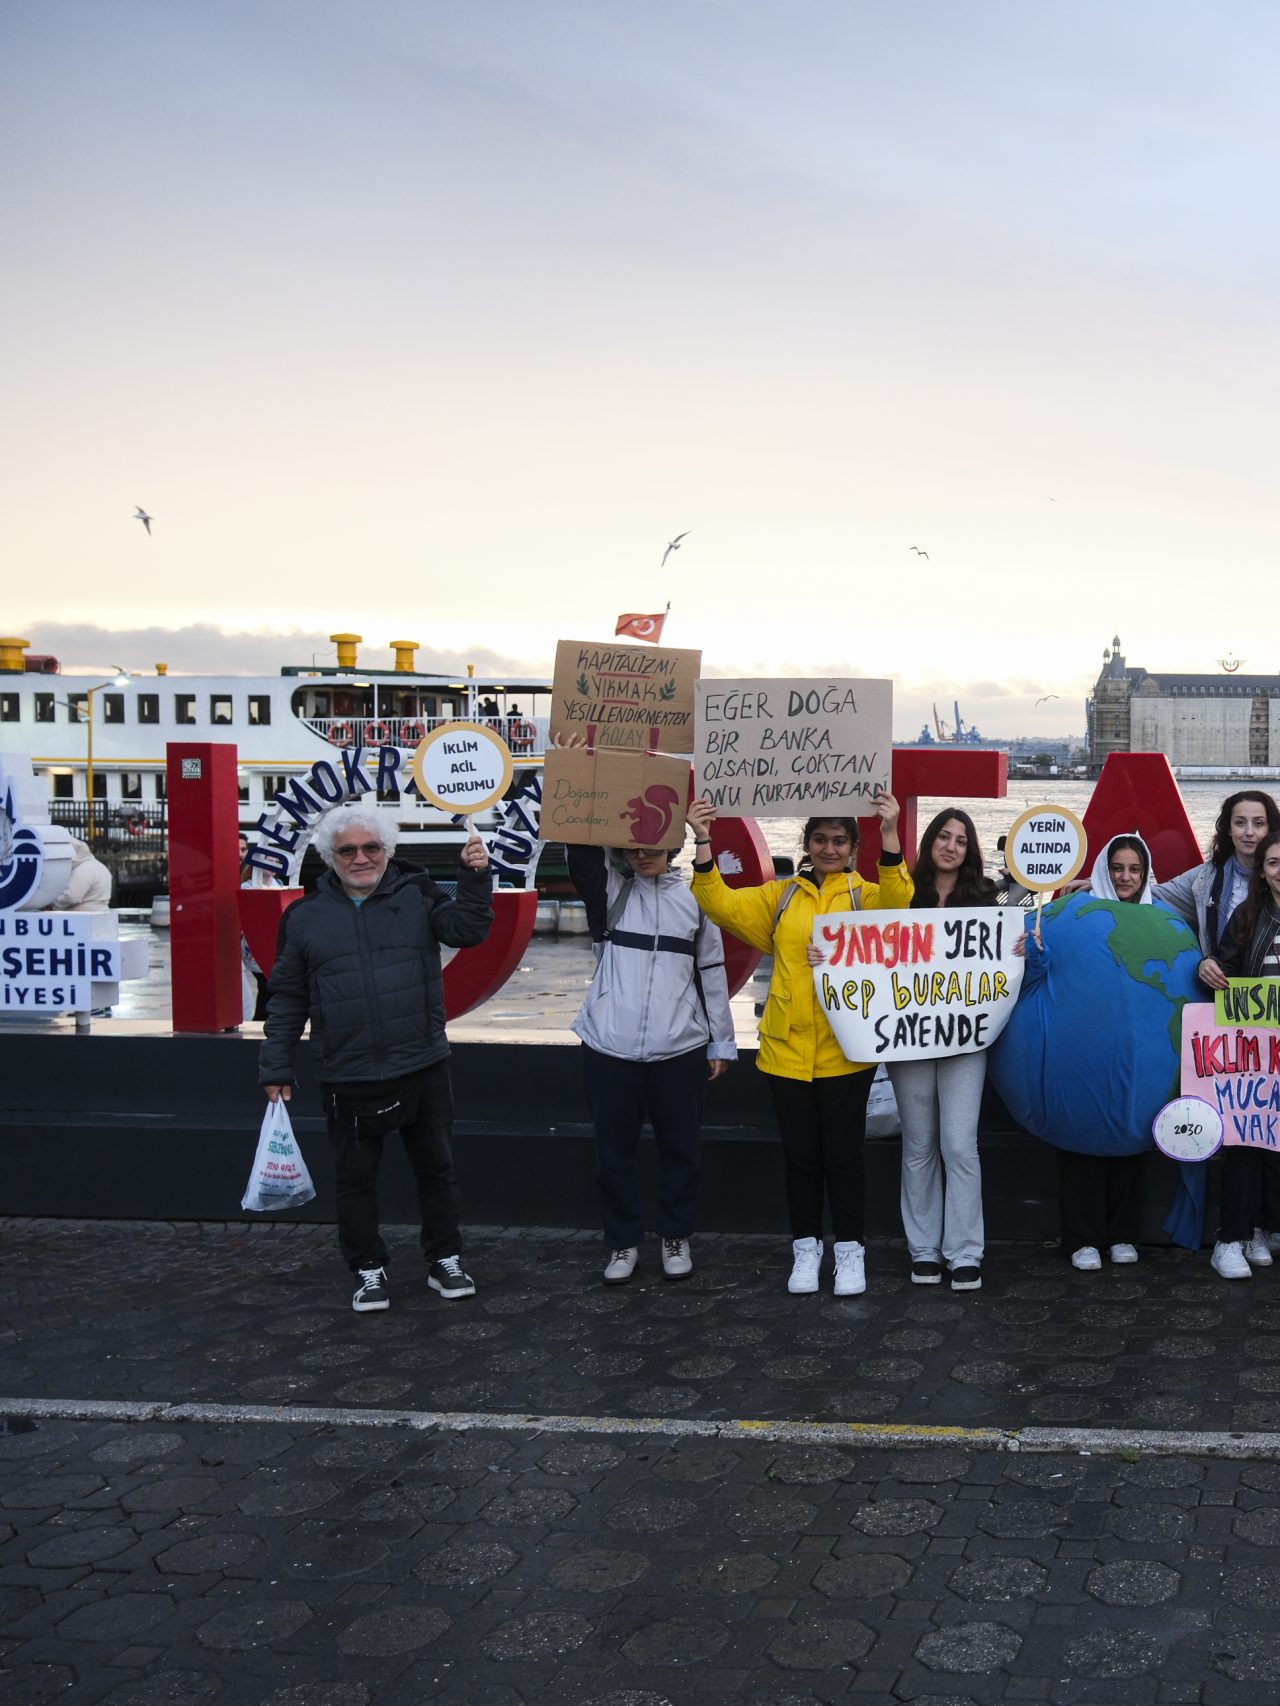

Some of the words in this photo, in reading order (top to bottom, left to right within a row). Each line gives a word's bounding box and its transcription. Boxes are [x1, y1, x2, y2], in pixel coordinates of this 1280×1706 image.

[592, 675, 657, 702] YIKMAK
[705, 690, 774, 722] EĞER
[787, 686, 859, 717] DOĞA
[443, 740, 479, 755] İKLİM
[706, 729, 740, 755] BİR
[760, 727, 833, 751] BANKA
[450, 760, 477, 773] ACİL
[791, 752, 878, 776] ÇOKTAN
[437, 779, 495, 794] DURUMU
[554, 779, 609, 808] Doğanın
[701, 785, 743, 807] ONU
[552, 805, 609, 827] Çocukları
[1029, 818, 1066, 833] YERİN
[1020, 842, 1071, 854] ALTINDA
[1027, 863, 1063, 875] BIRAK
[944, 911, 1004, 961] YERİ
[822, 972, 875, 1020] hep
[874, 1012, 989, 1054] SAYENDE
[1191, 1029, 1261, 1078] İKLİM
[1174, 1123, 1203, 1136] 2030
